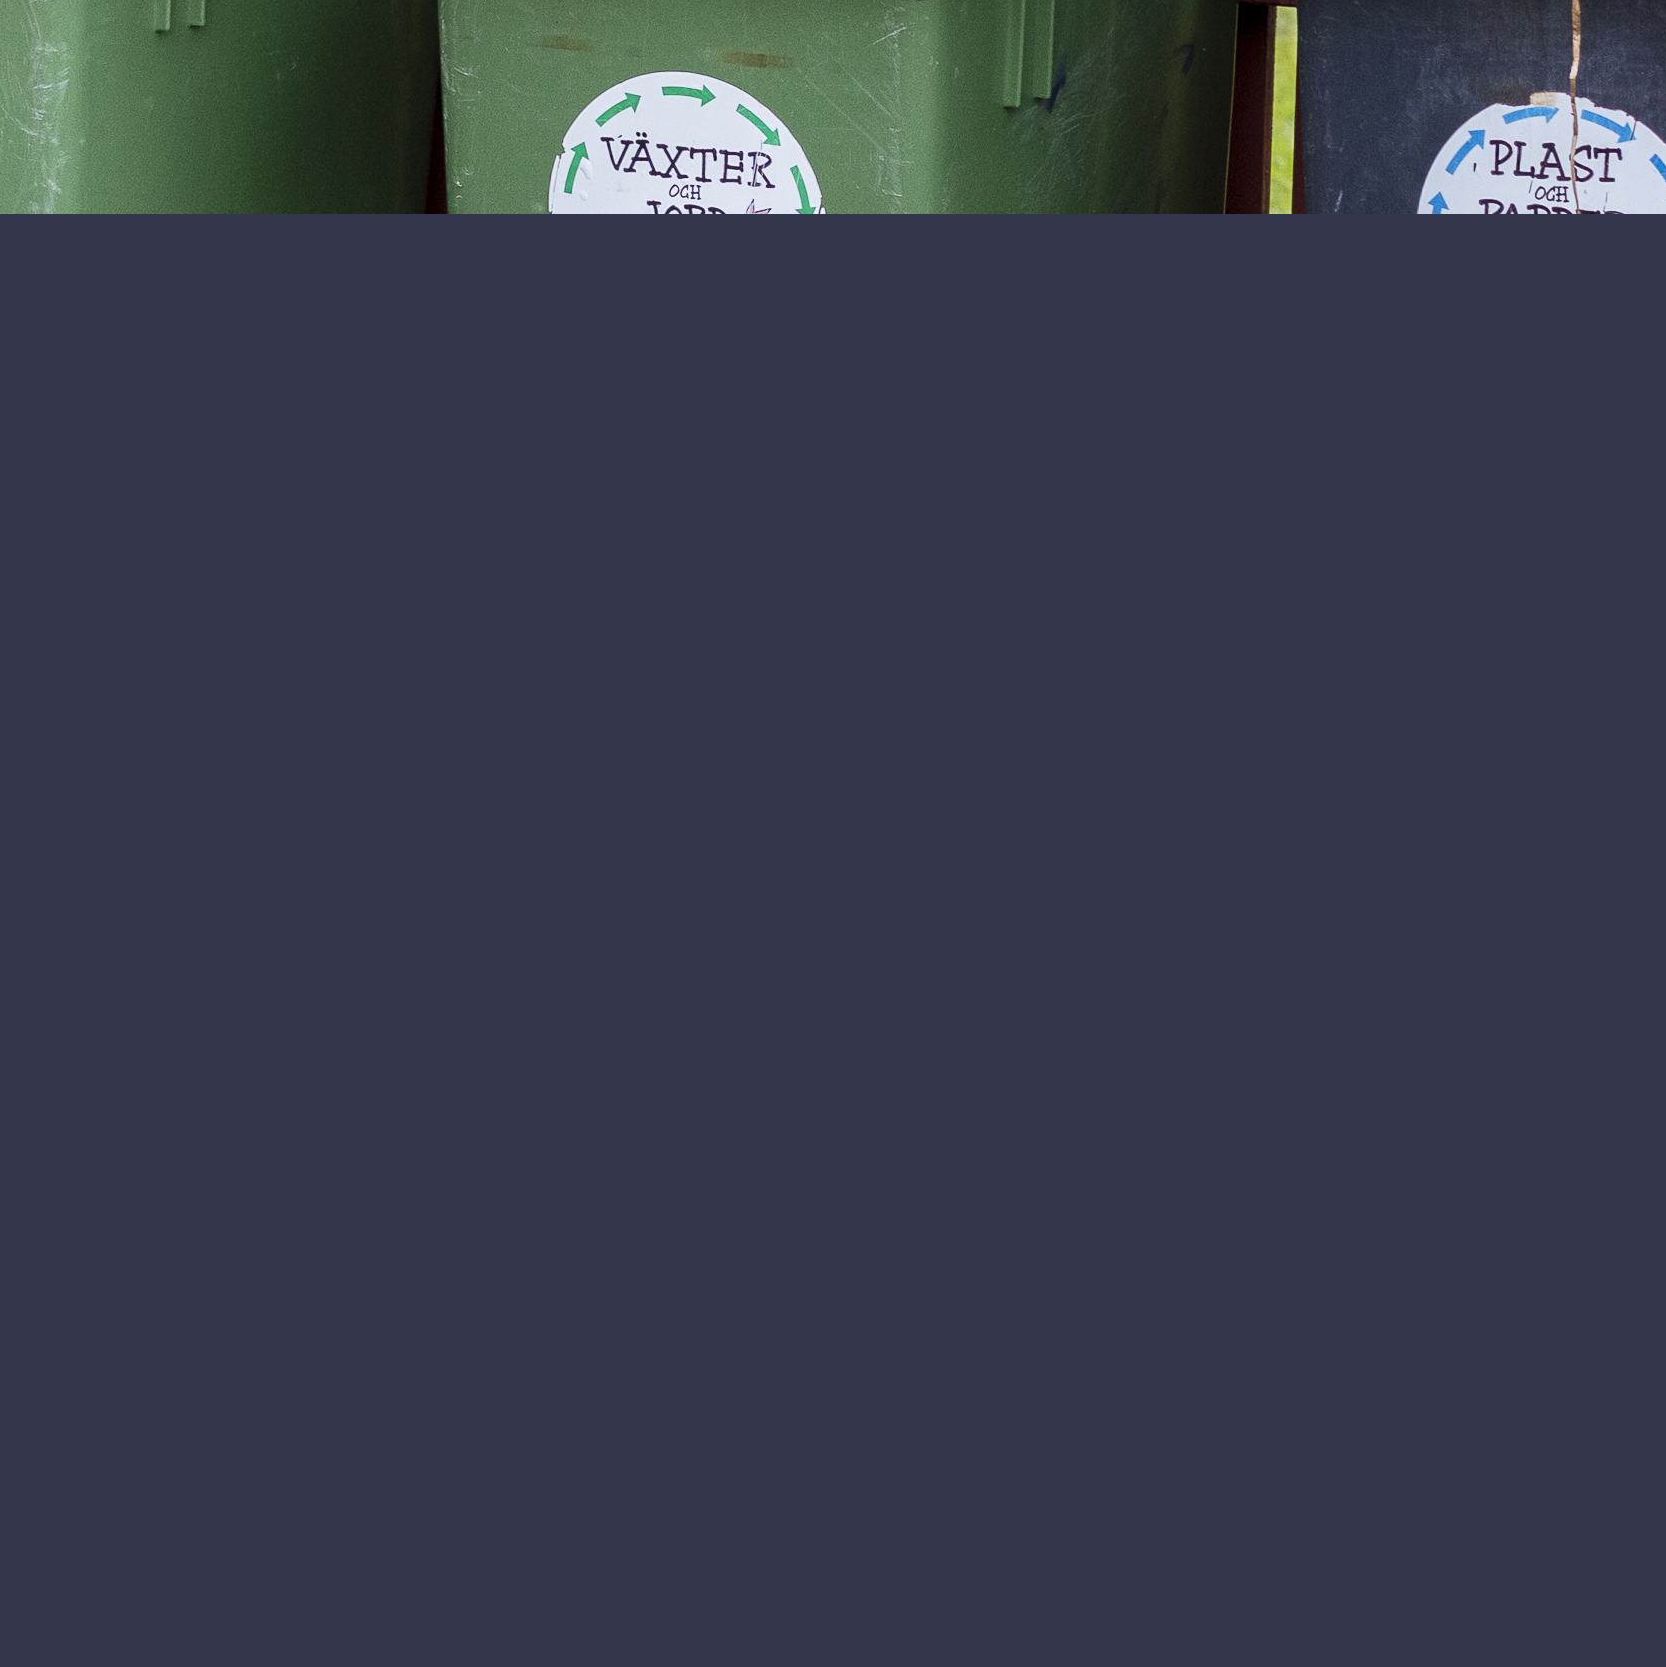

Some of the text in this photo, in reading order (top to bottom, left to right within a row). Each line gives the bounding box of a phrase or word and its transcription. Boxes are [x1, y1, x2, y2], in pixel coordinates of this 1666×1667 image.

[600, 130, 776, 189] VÄXTER
[1489, 139, 1623, 183] PLAST
[668, 183, 702, 201] OCH
[1534, 185, 1570, 203] OCH
